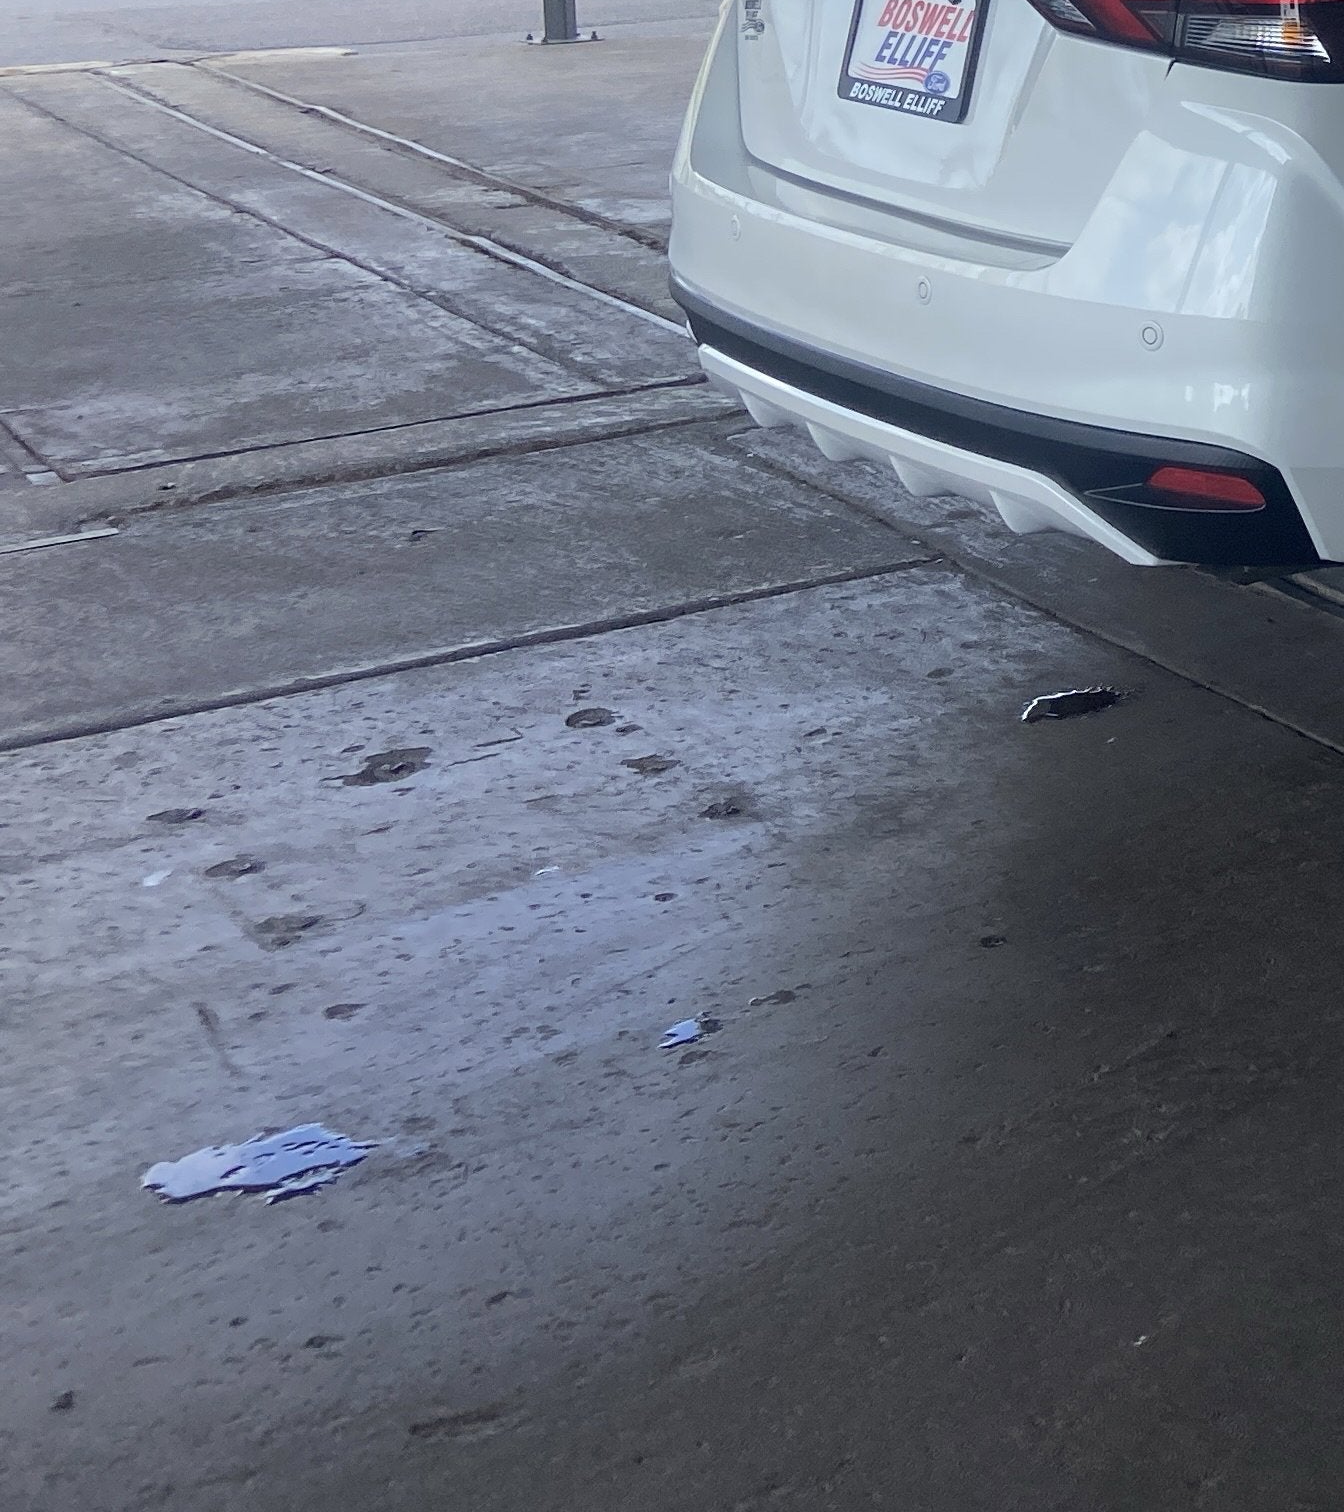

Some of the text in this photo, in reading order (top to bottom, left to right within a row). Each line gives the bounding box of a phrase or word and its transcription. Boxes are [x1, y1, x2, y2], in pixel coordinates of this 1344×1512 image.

[874, 30, 954, 72] ELLIFF
[849, 80, 946, 116] BOSWELL ELLIFF
